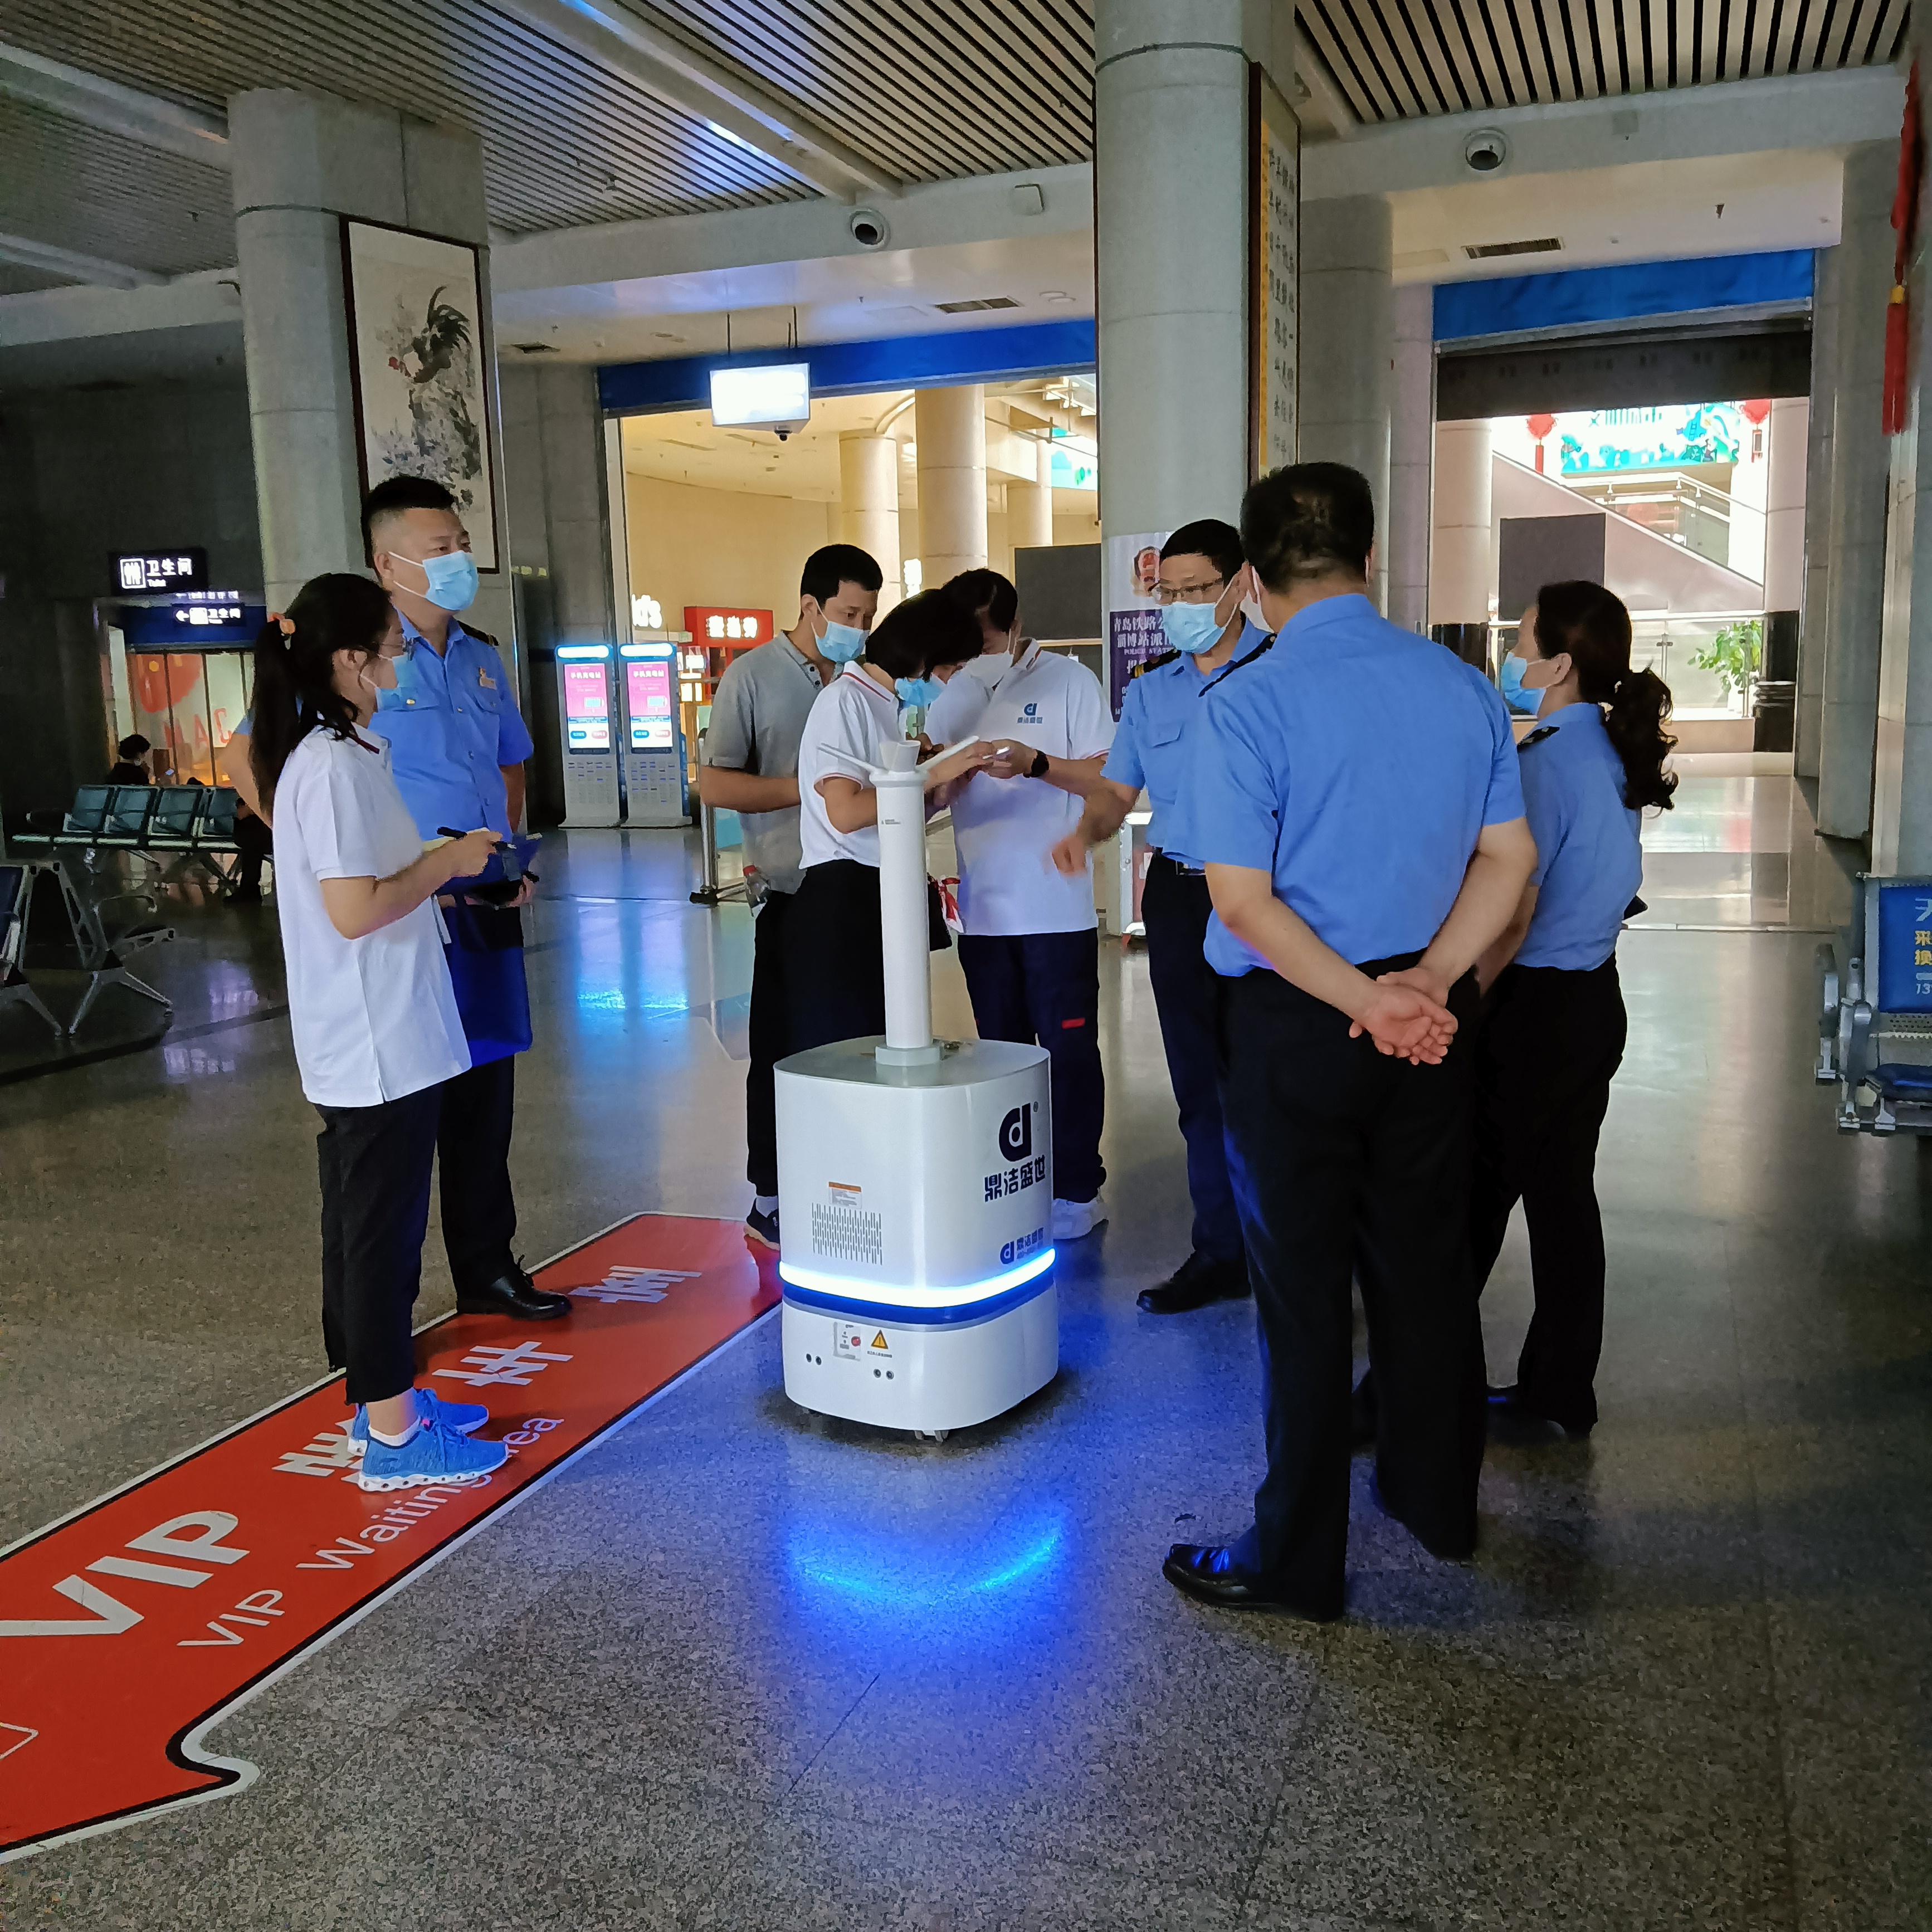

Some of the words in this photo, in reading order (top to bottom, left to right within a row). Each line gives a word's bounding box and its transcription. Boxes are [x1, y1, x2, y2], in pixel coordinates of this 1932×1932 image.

[146, 558, 193, 576] 卫生间
[984, 1154, 1046, 1202] 鼎洁盛世
[0, 1510, 250, 1637] VIP
[176, 1589, 285, 1647] VIP
